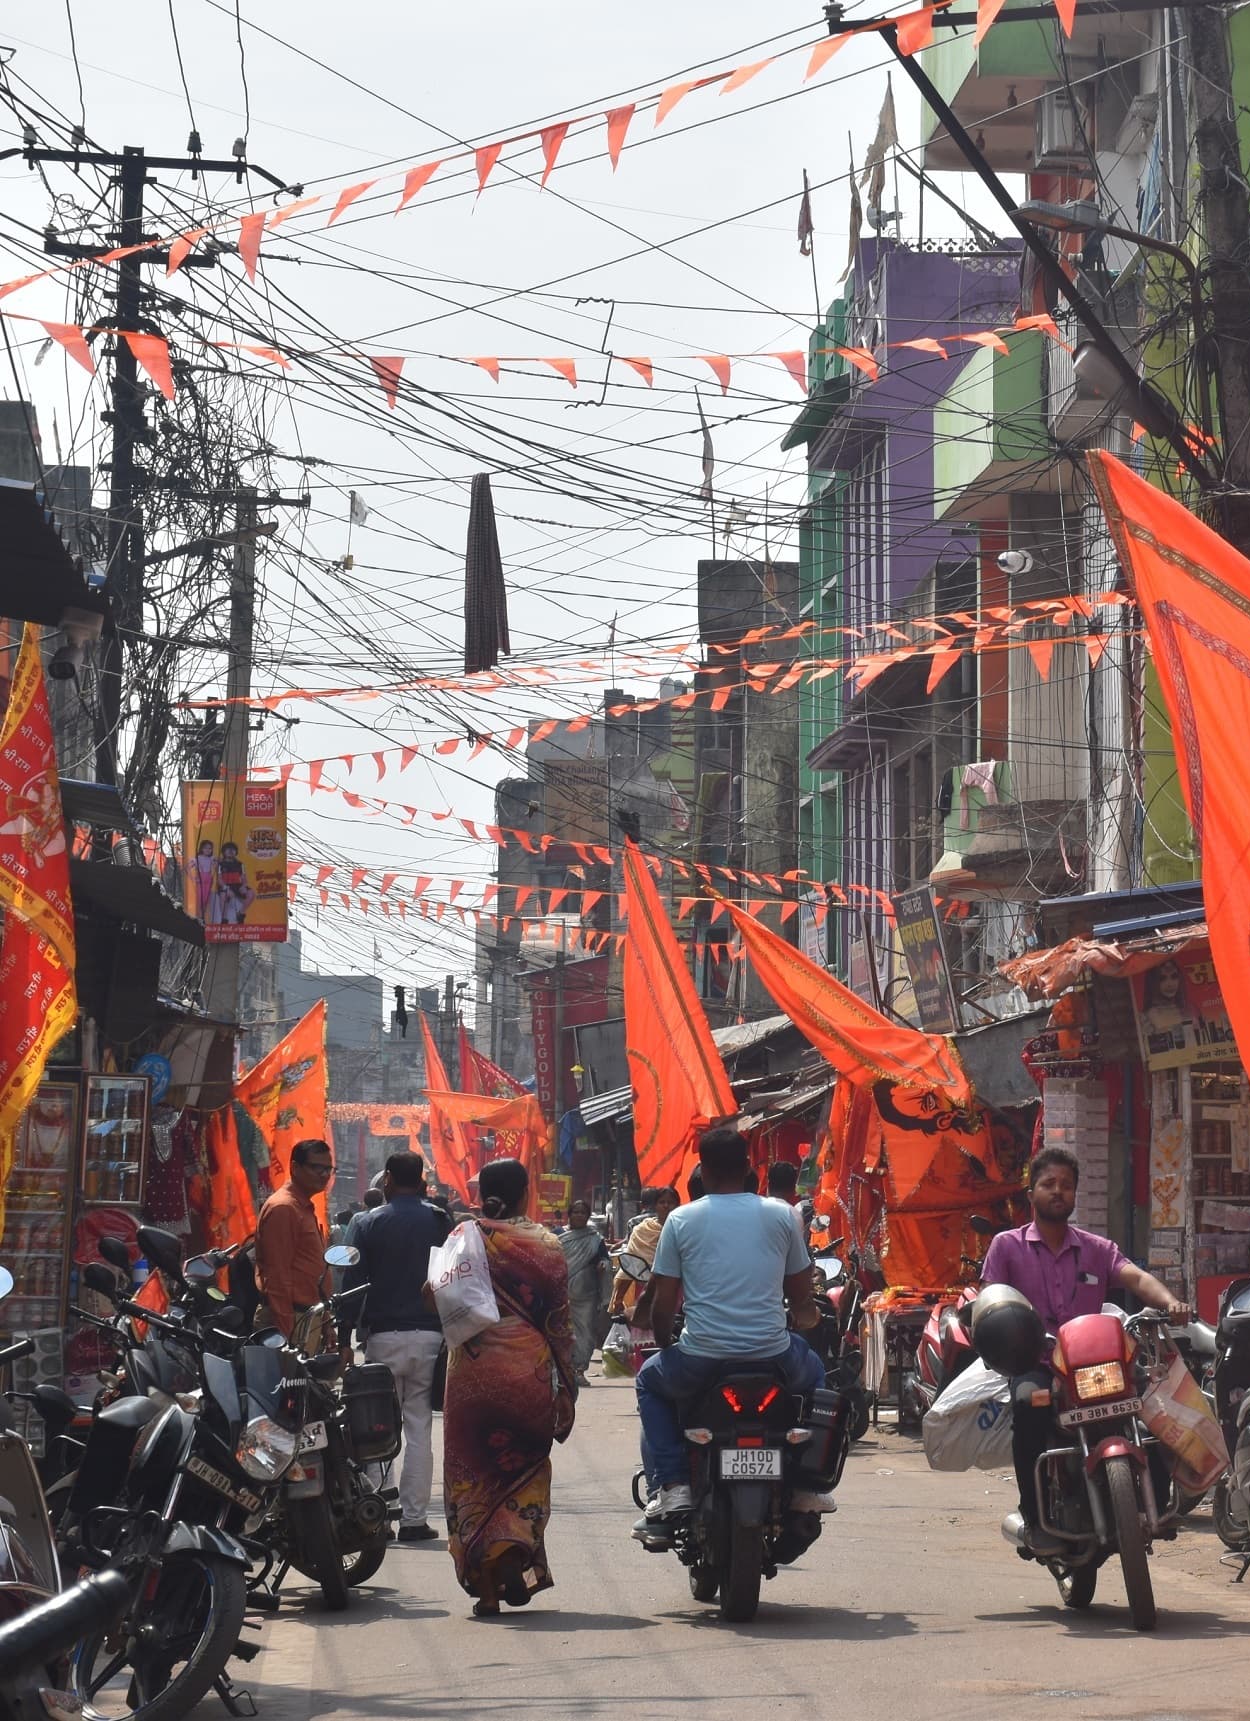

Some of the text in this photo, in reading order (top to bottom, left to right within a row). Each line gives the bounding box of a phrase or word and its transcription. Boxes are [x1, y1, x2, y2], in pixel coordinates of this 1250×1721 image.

[20, 725, 33, 738] श्री
[31, 736, 47, 751] राम
[4, 749, 31, 773] श्री राम
[246, 793, 273, 802] MEGA
[247, 803, 274, 812] SHOP
[1, 853, 28, 878] श्री राम
[45, 890, 57, 902] श्री
[732, 1451, 774, 1463] JH10D
[731, 1463, 774, 1475] C0574
